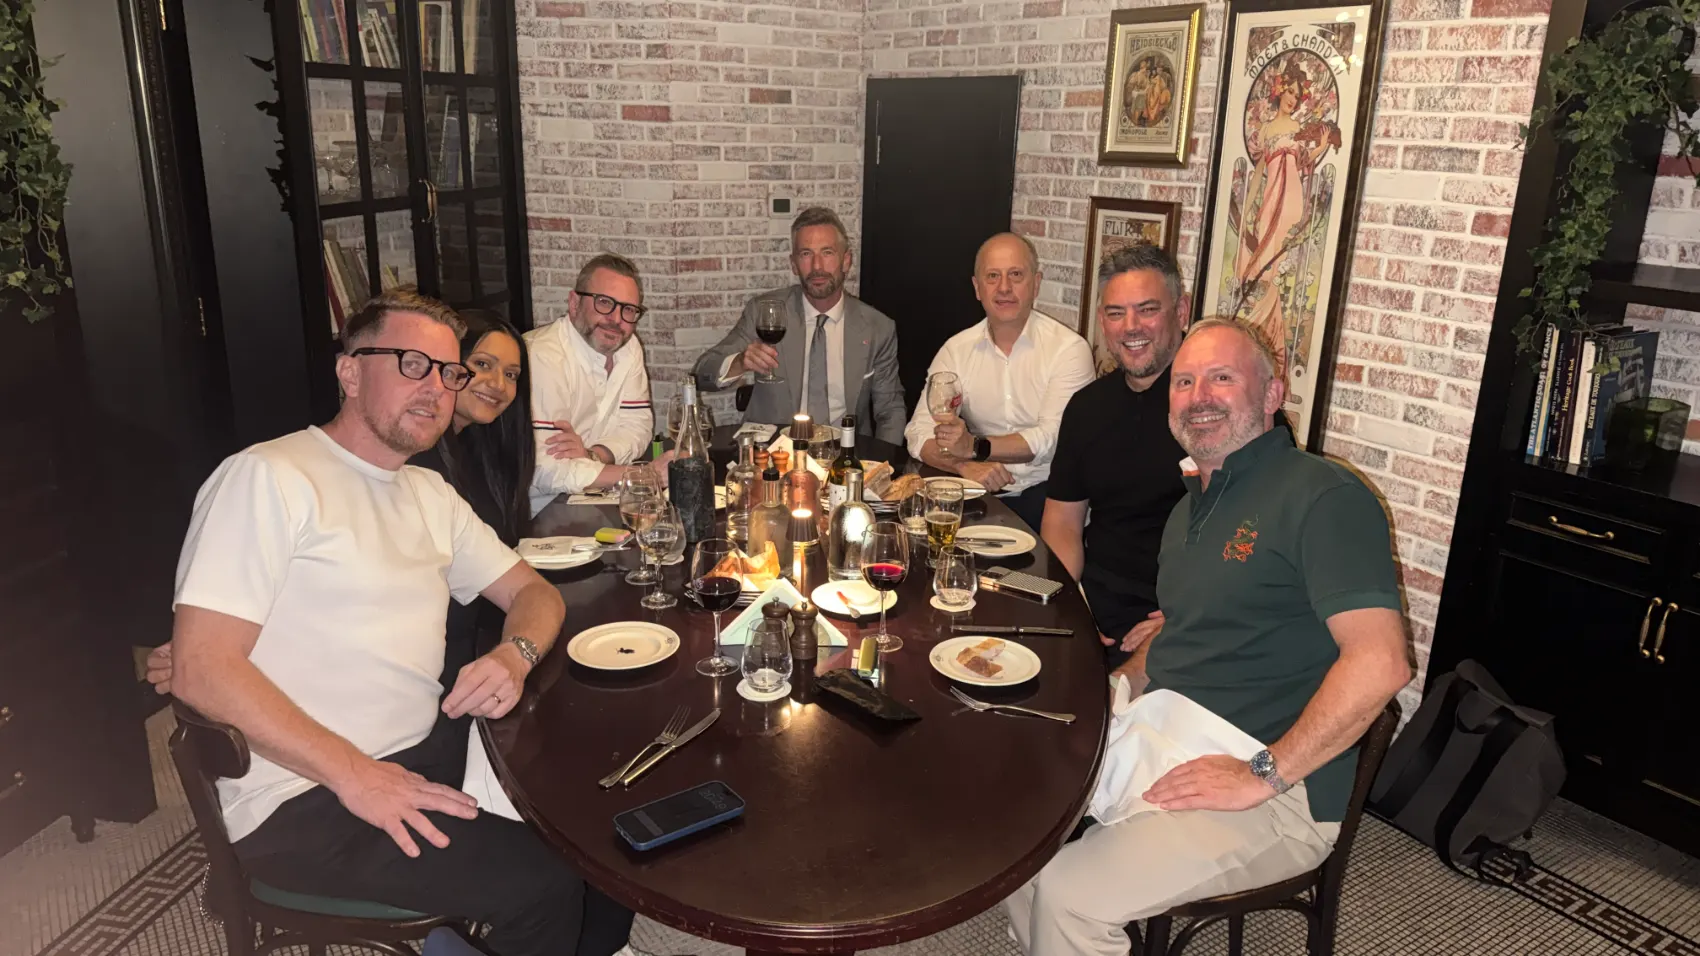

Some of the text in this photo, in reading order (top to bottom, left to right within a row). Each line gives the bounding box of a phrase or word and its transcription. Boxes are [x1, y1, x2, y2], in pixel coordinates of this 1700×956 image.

[1281, 39, 1289, 50] &
[1562, 386, 1572, 412] Heritage
[1530, 396, 1542, 434] ATLANTIC
[1527, 434, 1535, 450] THE
